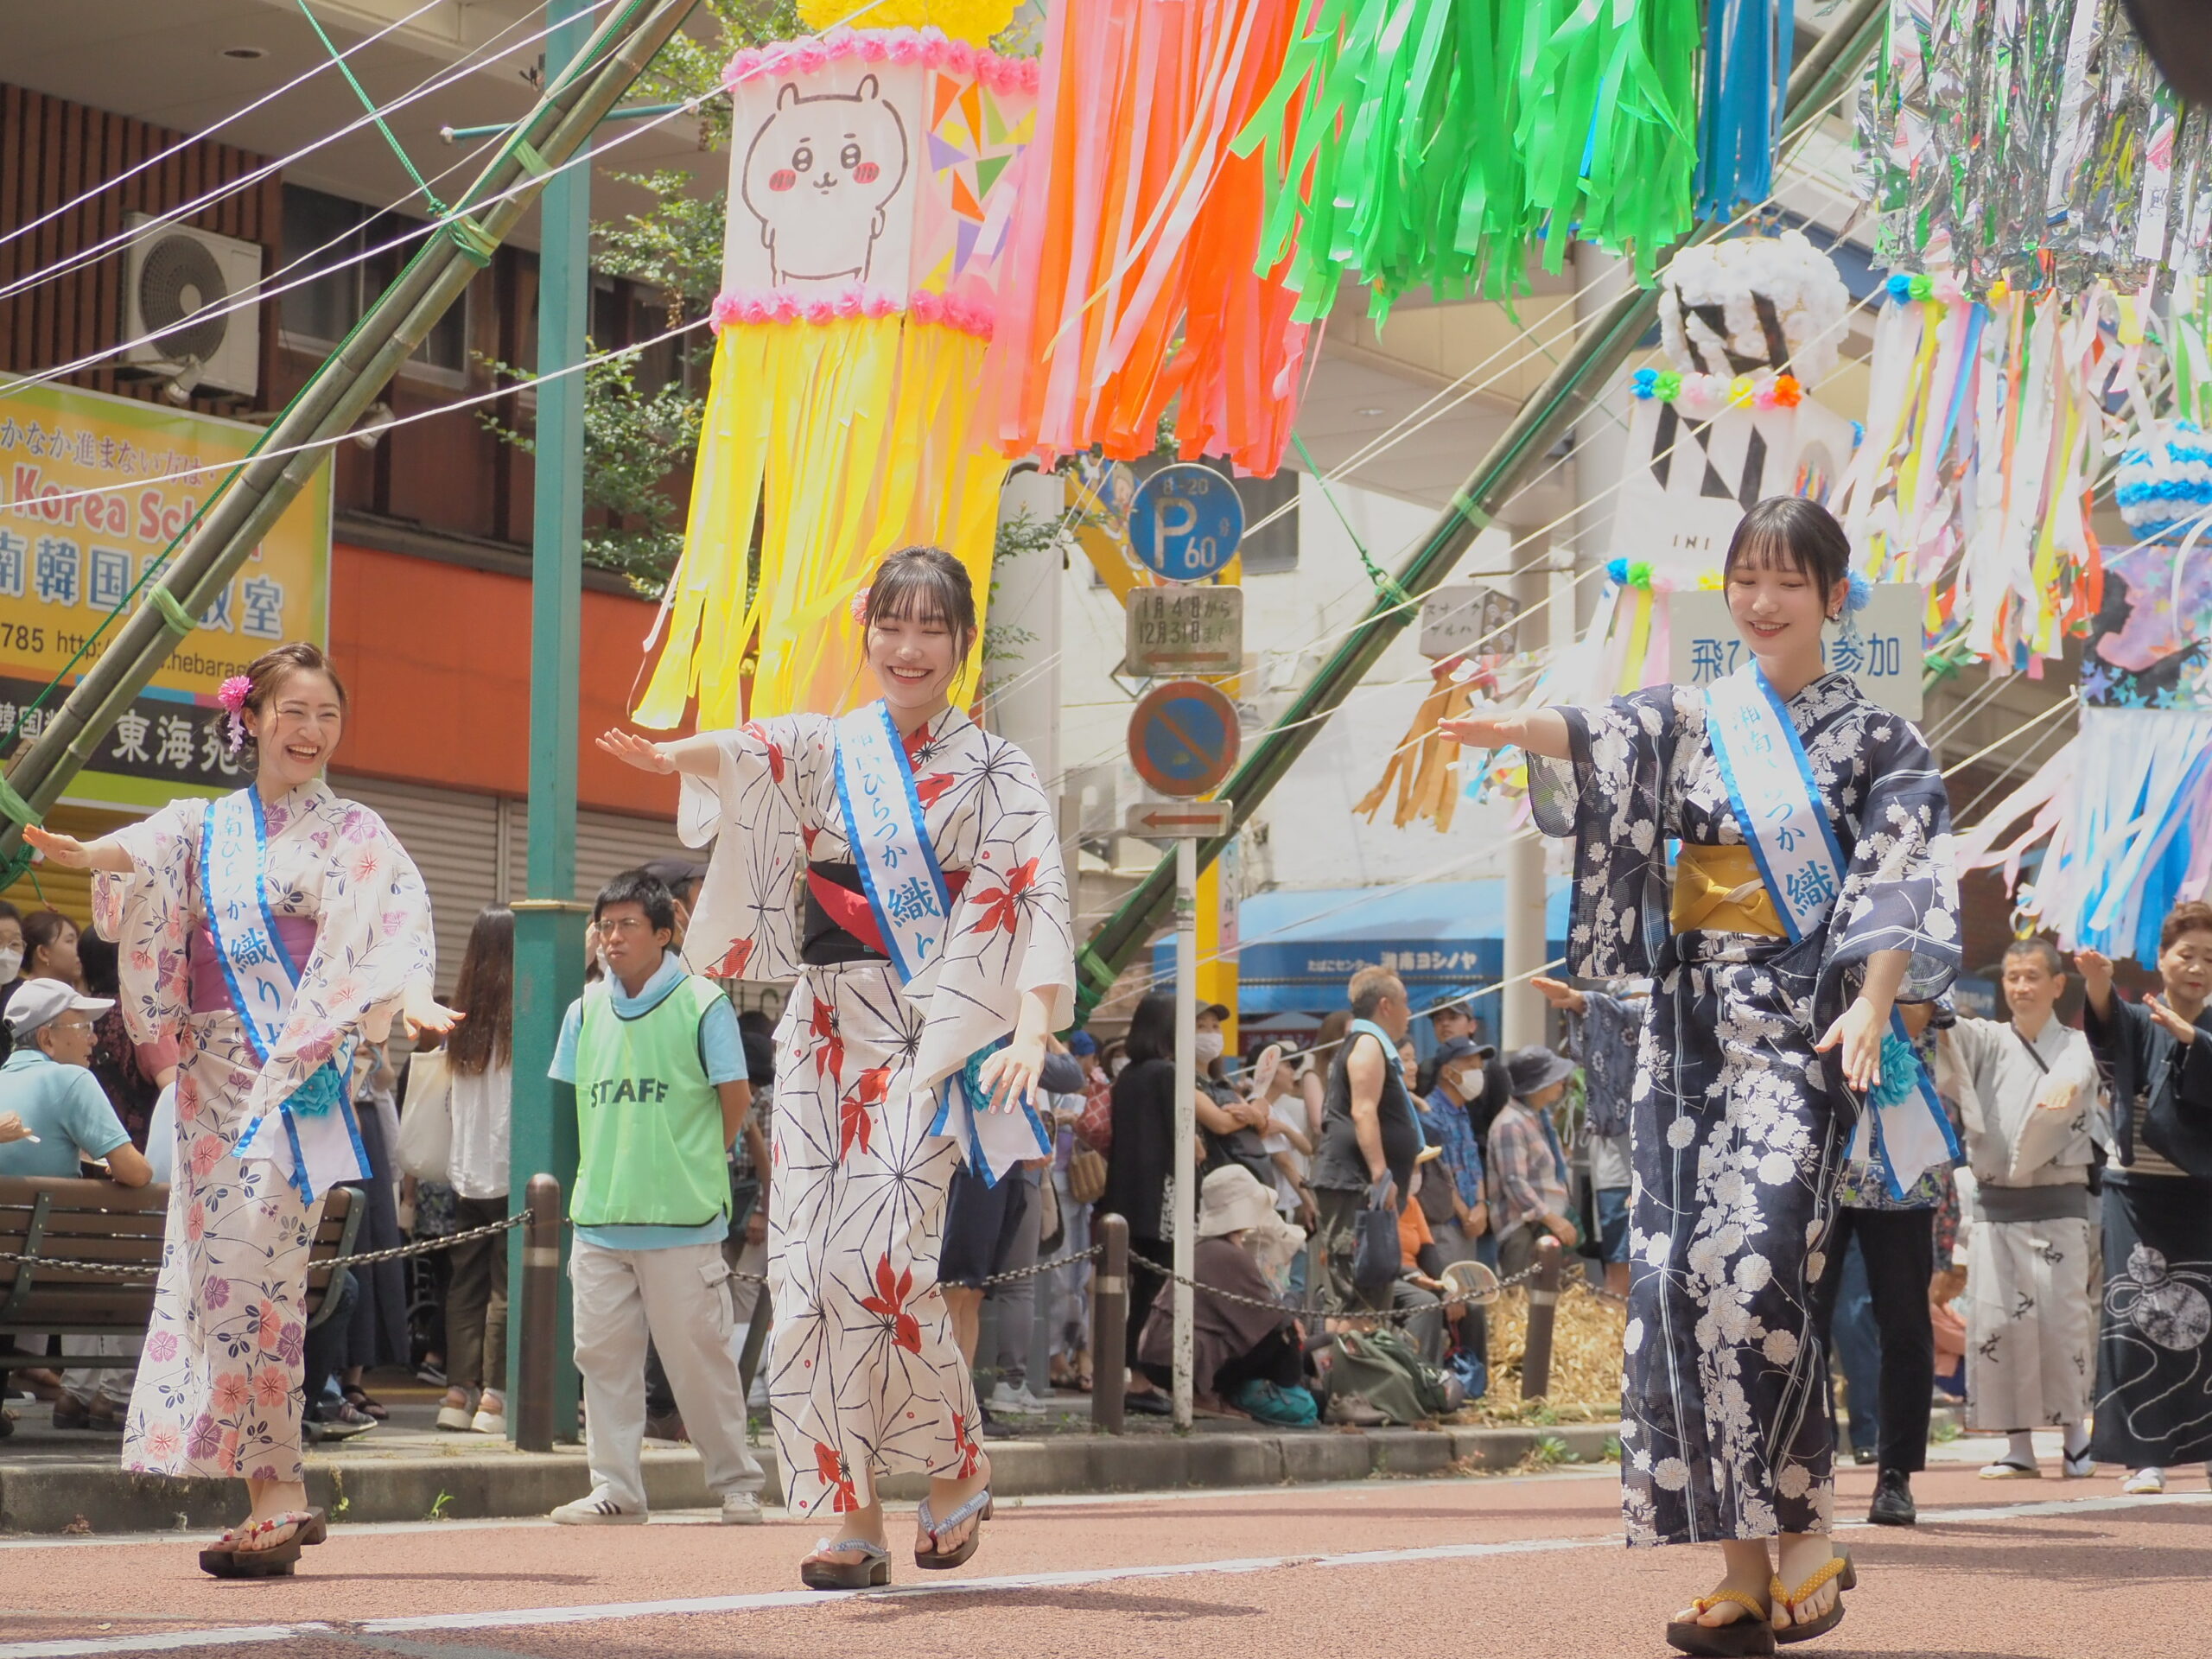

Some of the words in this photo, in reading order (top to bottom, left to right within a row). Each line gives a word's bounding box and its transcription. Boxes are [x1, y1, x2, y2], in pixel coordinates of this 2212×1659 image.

[15, 466, 127, 534] Korea
[1154, 498, 1197, 569] P
[1673, 535, 1710, 550] INI
[1185, 537, 1217, 569] 60
[1, 622, 44, 653] 785
[112, 709, 238, 774] 東海苑
[591, 1078, 669, 1108] STAFF
